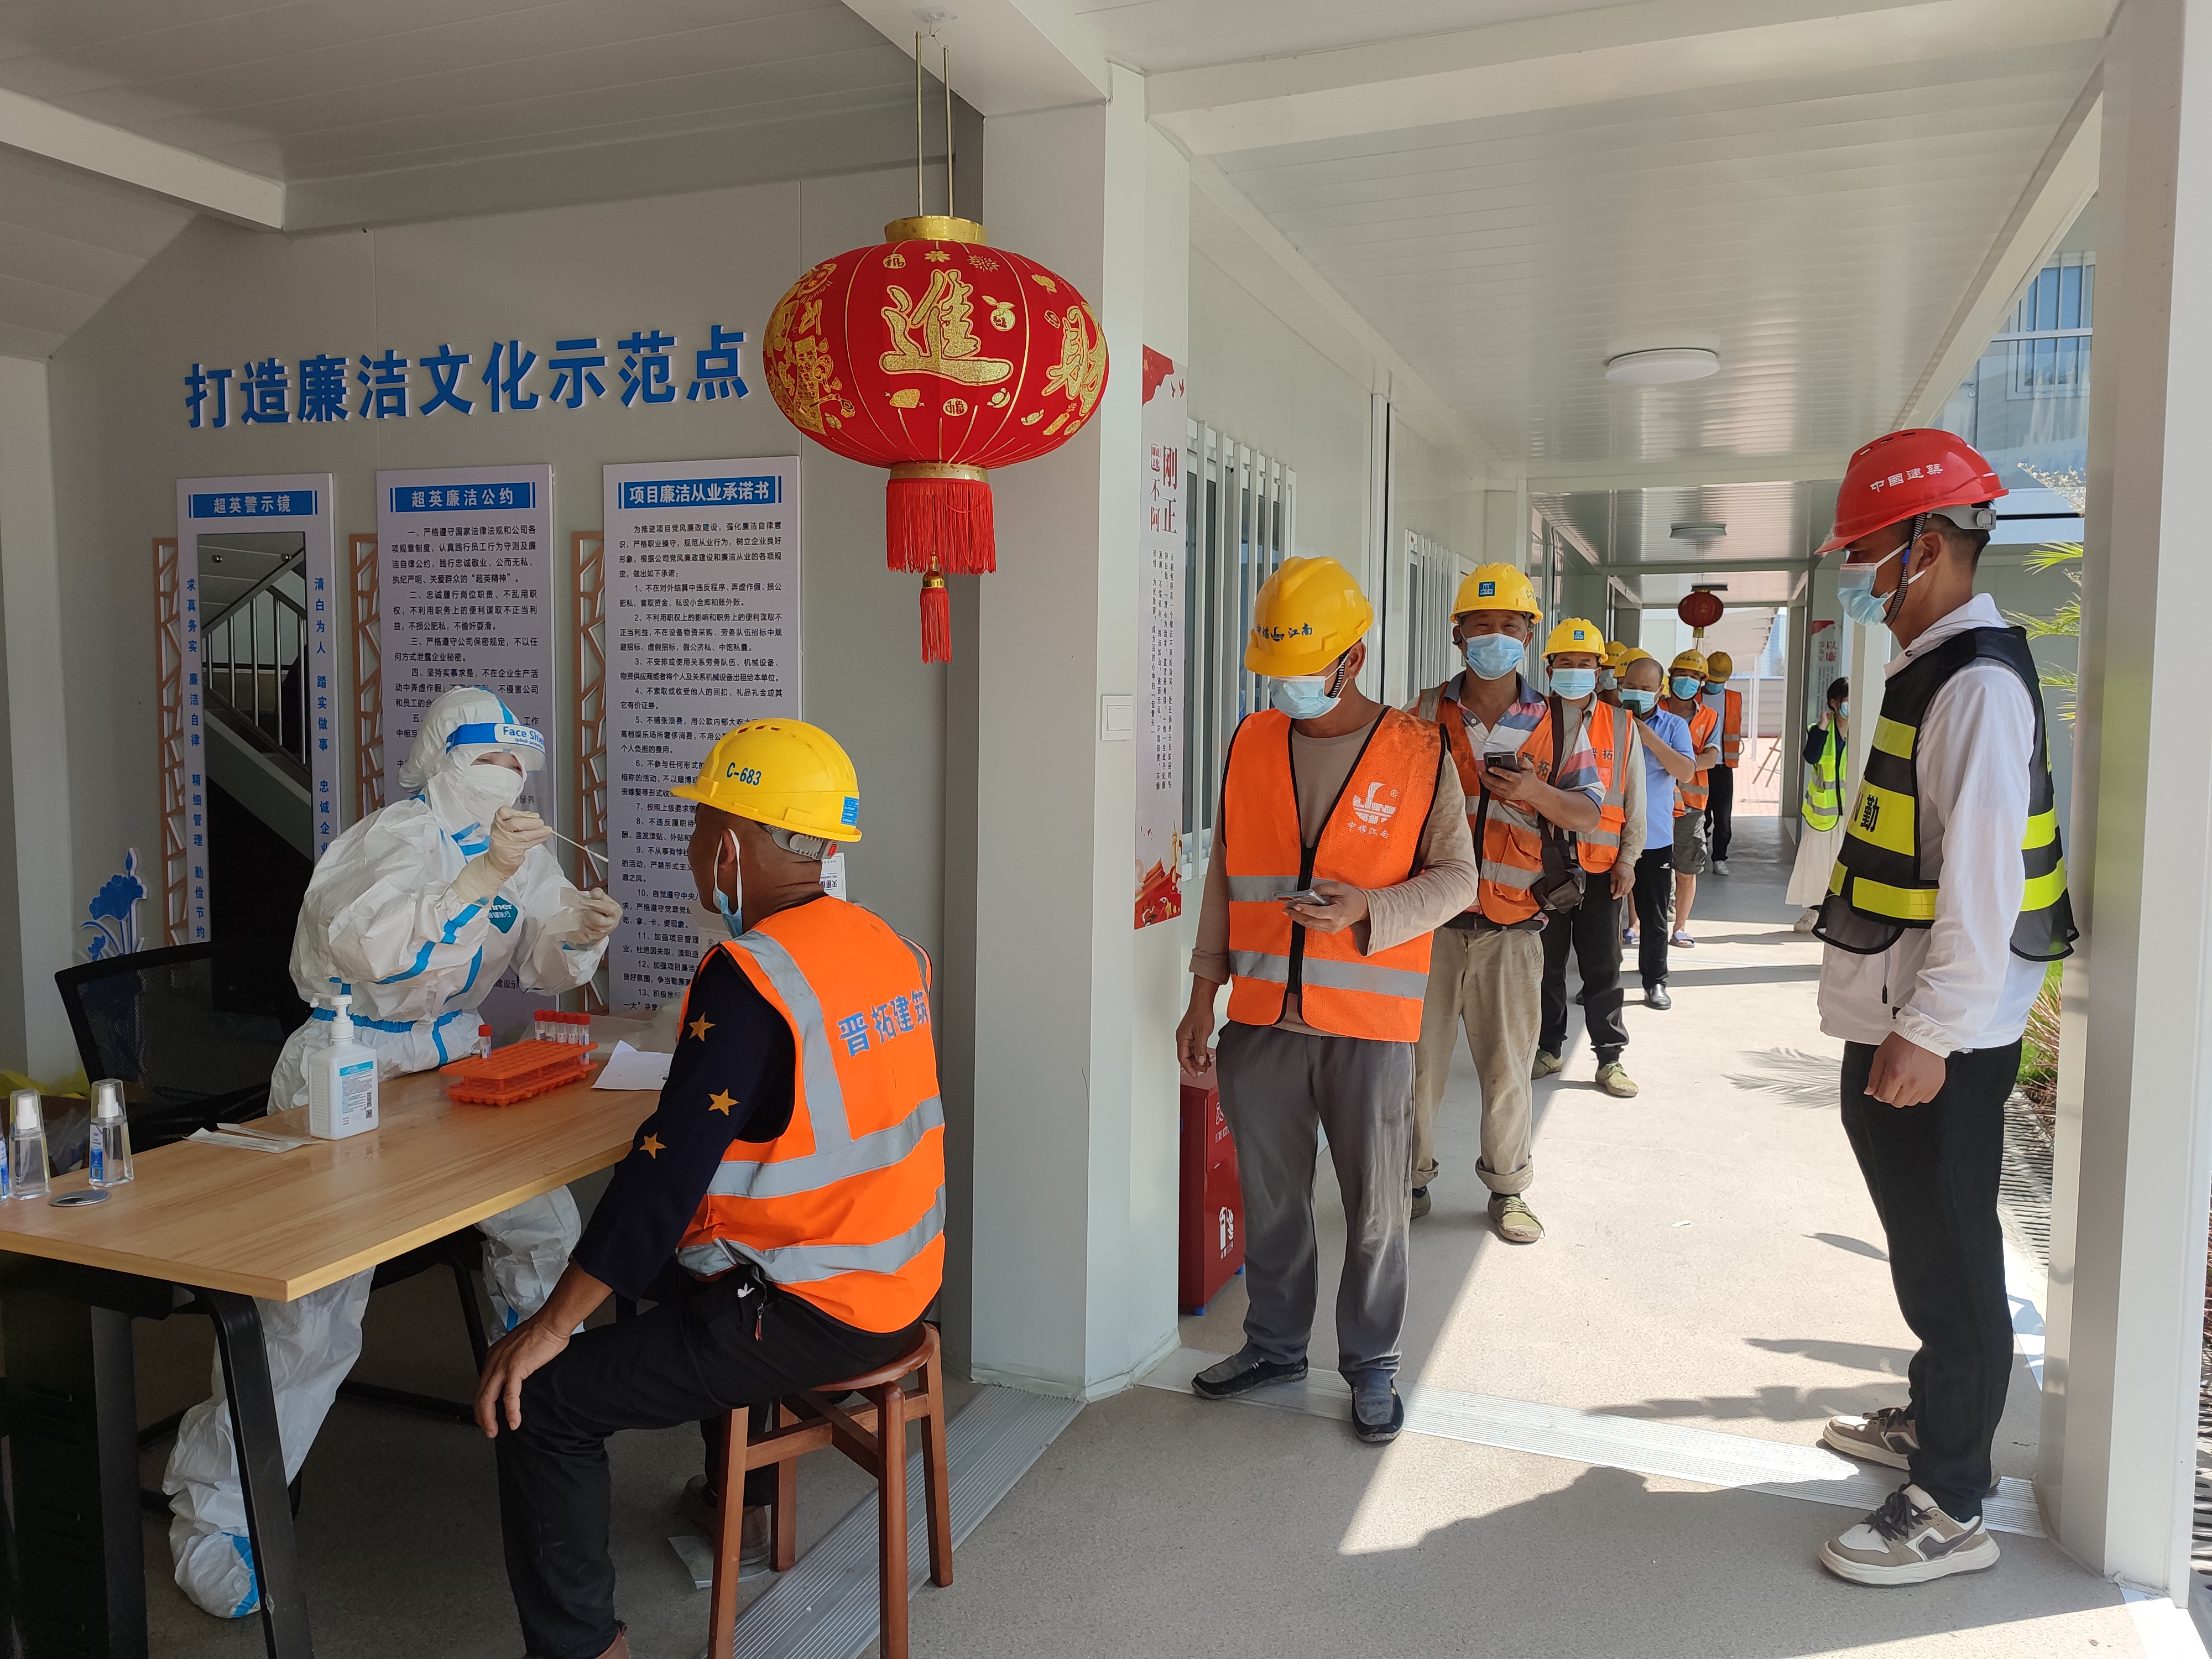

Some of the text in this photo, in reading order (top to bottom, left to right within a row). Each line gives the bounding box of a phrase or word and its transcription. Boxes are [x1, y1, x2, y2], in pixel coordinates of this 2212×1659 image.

[185, 324, 751, 428] 打造廉洁文化示范点
[629, 480, 770, 503] 项目廉洁从业承诺书
[1162, 445, 1178, 534] 刚正
[411, 487, 514, 508] 超英廉洁公约
[213, 494, 291, 515] 超英警示镜
[1150, 477, 1161, 533] 不阿
[408, 525, 536, 537] 一、严格遵守国家法律法规和公司各
[634, 521, 782, 534] 为推进项目党风廉政建设，强化廉洁自律意
[392, 541, 536, 553] 项规章制度，认真践行员工行为守则及廉
[619, 536, 782, 549] 识，严格职业操守，规范从业行为，树立企业良好
[392, 557, 535, 568] 洁自律公约，践行忠诚敬业、公而无私、
[619, 552, 782, 564] 形象，根据公司党风廉政建设和廉洁从业的各项规
[619, 569, 679, 578] 定，做出如下承诺：
[634, 582, 782, 593] 1、不在对外结算中违反程序、弄虚作假、损公
[410, 589, 538, 599] 二、忠诚履行岗位职责、不乱用职
[619, 598, 745, 607] 肥私，套取资金、私设小金库和账外账。
[314, 577, 326, 654] 清白为人
[393, 606, 538, 615] 权，不利用职务上的便利谋取不正当利
[634, 613, 782, 622] 2、不利用职权上的影响和职务上的便利谋取不
[393, 621, 497, 631] 益，不损公肥私，不偷奸耍滑。
[410, 637, 538, 646] 三、严格遵守公司保密规定，不以任
[619, 643, 753, 651] 避招标、虚假招标，假公济私、中饱私囊。
[394, 653, 466, 662] 何方式泄露企业秘密。
[634, 658, 779, 667] 3、不安排或使用关系劳务队伍、机械设备、
[411, 668, 539, 678] 四、坚持实事求是，不在企业生产活
[634, 687, 782, 697] 4、不索取或收受他人的回扣、礼品礼金或其
[395, 699, 435, 708] 和员工的合
[620, 701, 659, 710] 它有价证券。
[317, 675, 328, 752] 踏实做事
[635, 716, 759, 726] 5、不铺张浪费，用公款内部大吃
[502, 726, 527, 738] Face
[620, 730, 727, 740] 高档娱乐场所奢侈消费，不用公
[620, 744, 674, 754] 个人负担的费用。
[186, 578, 205, 938] 求真务实 廉洁自律 精细管理 勤俭节约
[726, 761, 762, 786] C-683
[620, 787, 677, 797] 丧嫁娶等形式收
[622, 916, 688, 928] 吃、拿、卡、要现象。
[638, 960, 698, 973] 12、加强项目廉洁
